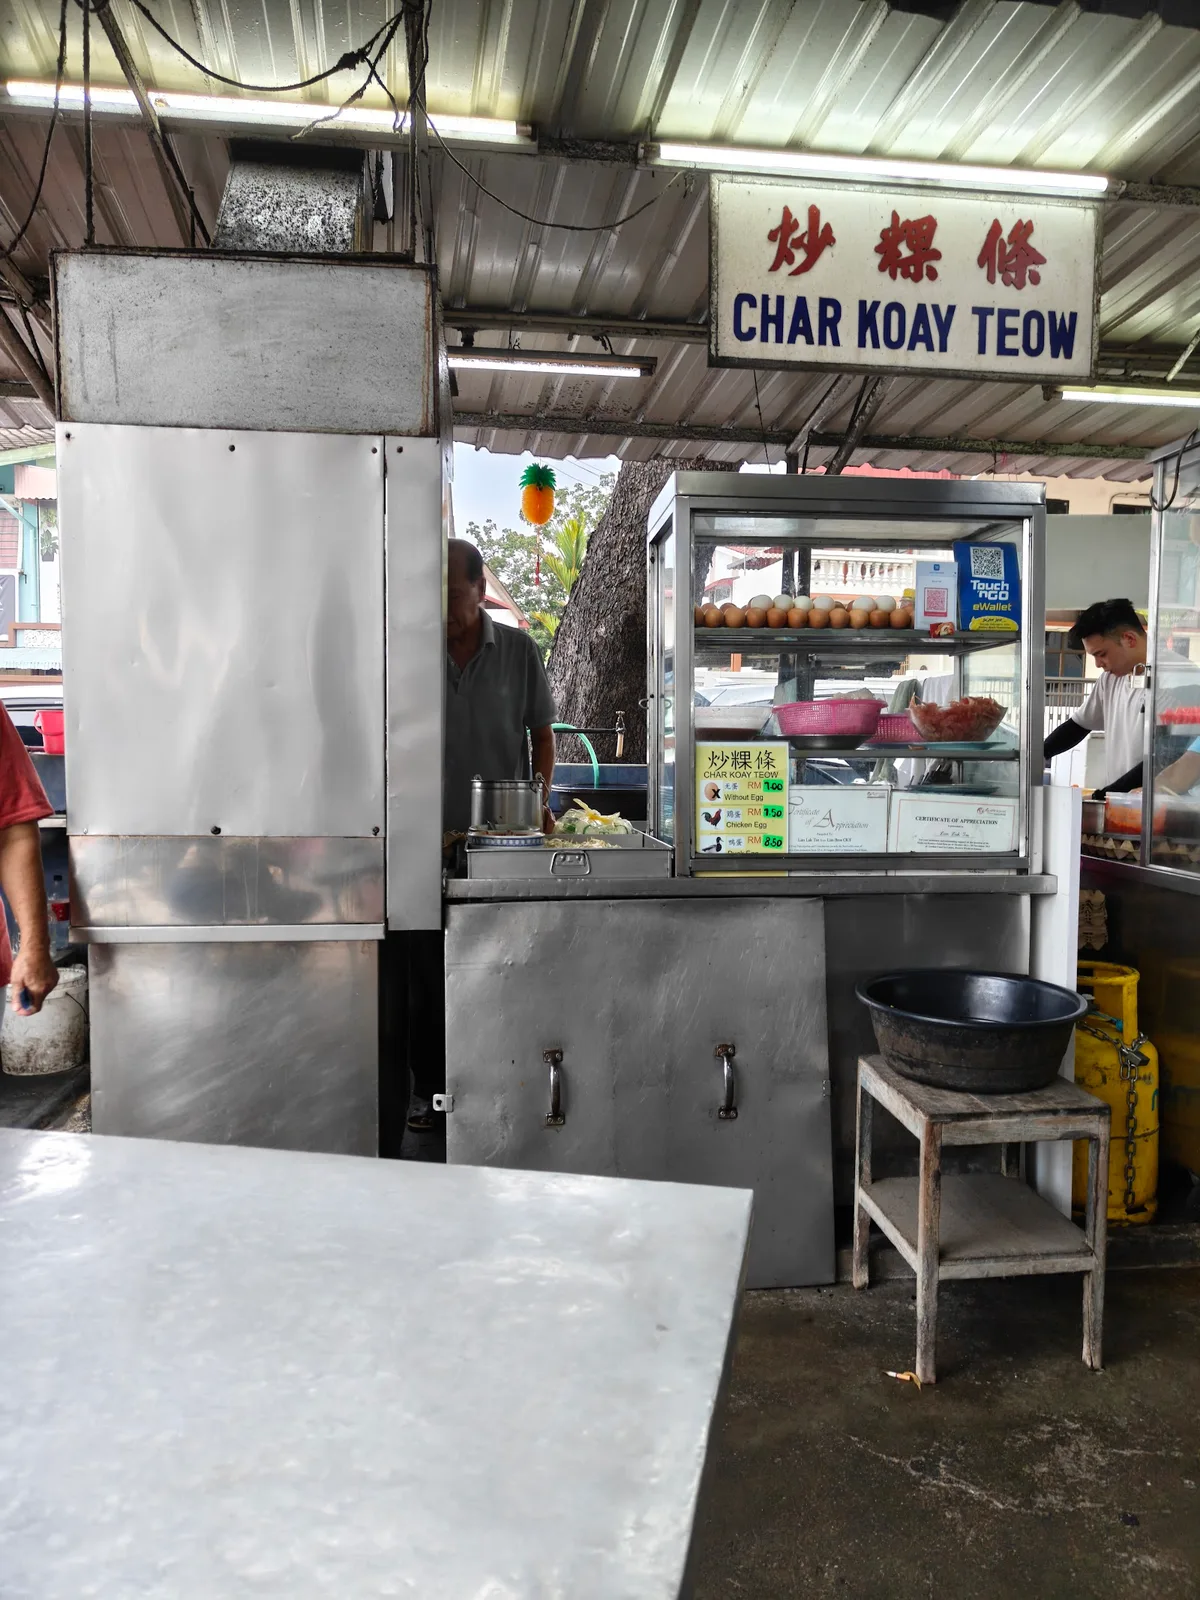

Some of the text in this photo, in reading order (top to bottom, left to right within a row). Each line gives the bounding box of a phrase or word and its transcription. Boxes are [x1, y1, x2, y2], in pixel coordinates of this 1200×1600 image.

[767, 203, 1047, 290] 炒粿條
[733, 292, 1078, 359] CHAR KOAY TEOW
[970, 579, 1010, 591] Touch
[972, 602, 1012, 611] eWallet
[708, 750, 777, 771] 炒粿條
[703, 771, 779, 779] CHAR KOAY TEOW
[747, 781, 762, 789] RM
[724, 793, 764, 802] Without Egg
[747, 808, 762, 816] RM
[915, 815, 950, 823] CERTIFICATE
[753, 821, 767, 830] Egg
[747, 836, 762, 844] RM
